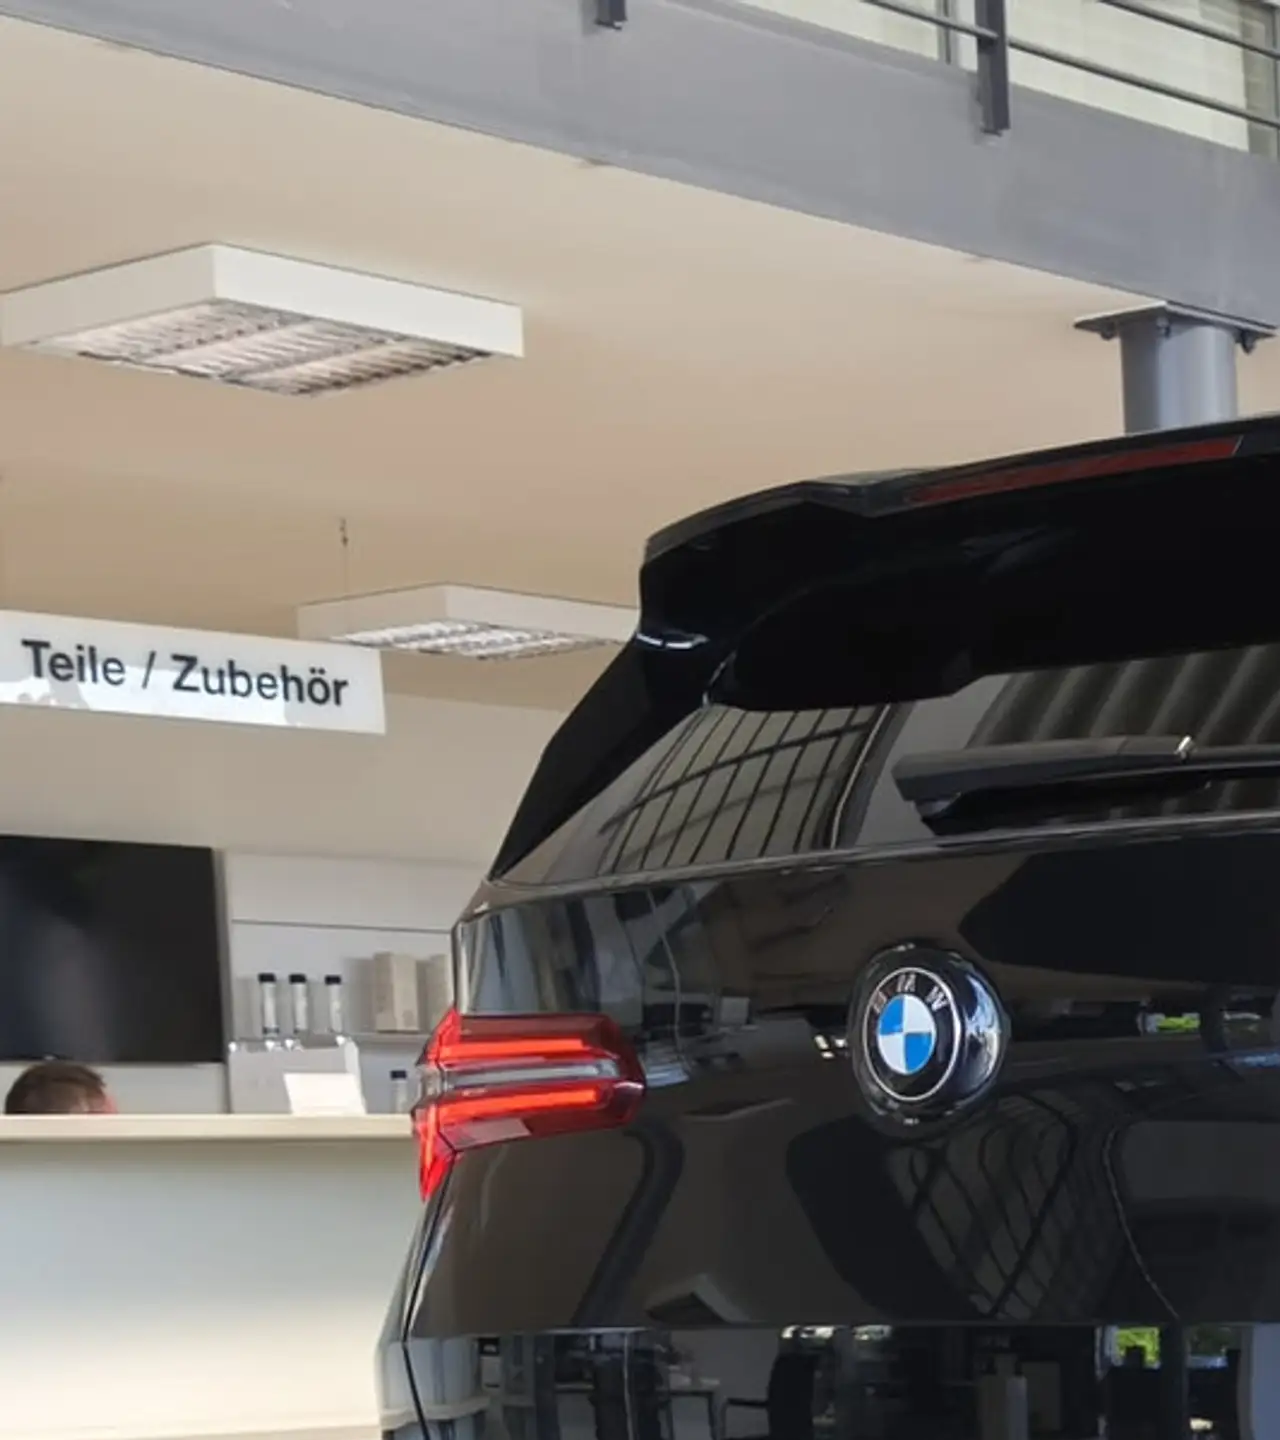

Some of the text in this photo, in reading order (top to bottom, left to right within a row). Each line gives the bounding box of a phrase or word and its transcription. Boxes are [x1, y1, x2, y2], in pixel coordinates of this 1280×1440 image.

[22, 639, 348, 706] Teile / Zubehör
[873, 974, 950, 1013] BMW
